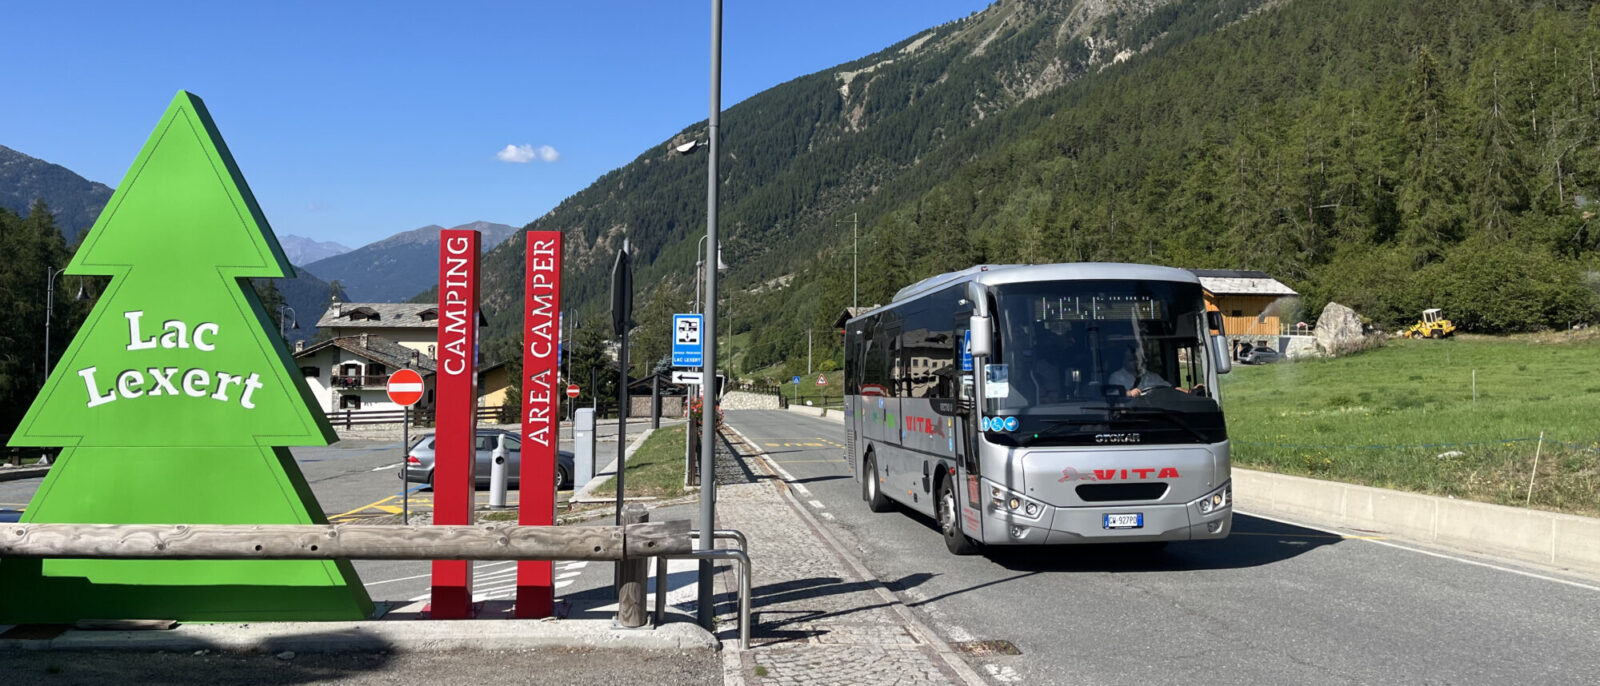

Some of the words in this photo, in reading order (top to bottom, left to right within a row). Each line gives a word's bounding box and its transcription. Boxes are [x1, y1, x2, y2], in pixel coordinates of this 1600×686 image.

[444, 236, 469, 376] CAMPING
[530, 239, 555, 359] CAMPER
[124, 310, 220, 352] Lac
[77, 366, 264, 409] Lexert
[528, 368, 551, 447] AREA
[905, 415, 933, 435] VITA
[1095, 433, 1141, 443] OTOKAR
[1093, 467, 1180, 480] VITA
